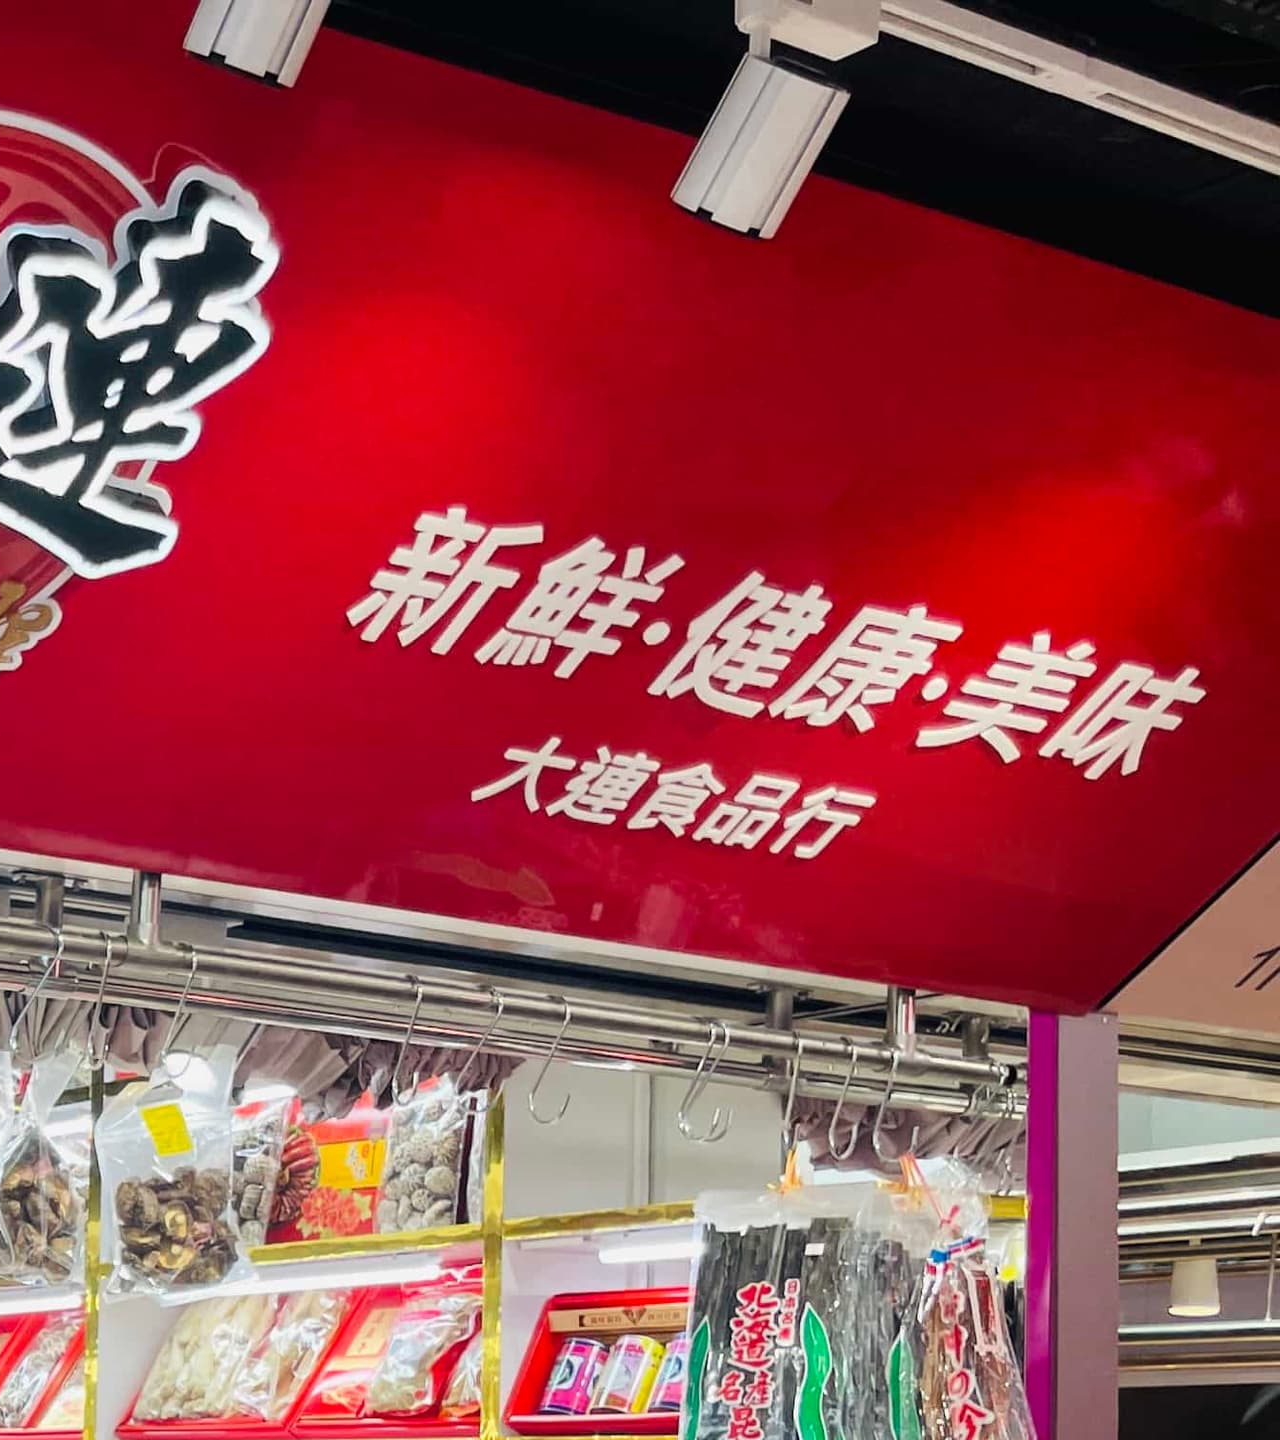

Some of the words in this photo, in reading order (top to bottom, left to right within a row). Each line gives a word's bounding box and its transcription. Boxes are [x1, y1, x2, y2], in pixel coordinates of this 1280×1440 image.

[471, 736, 878, 860] 大連食品行
